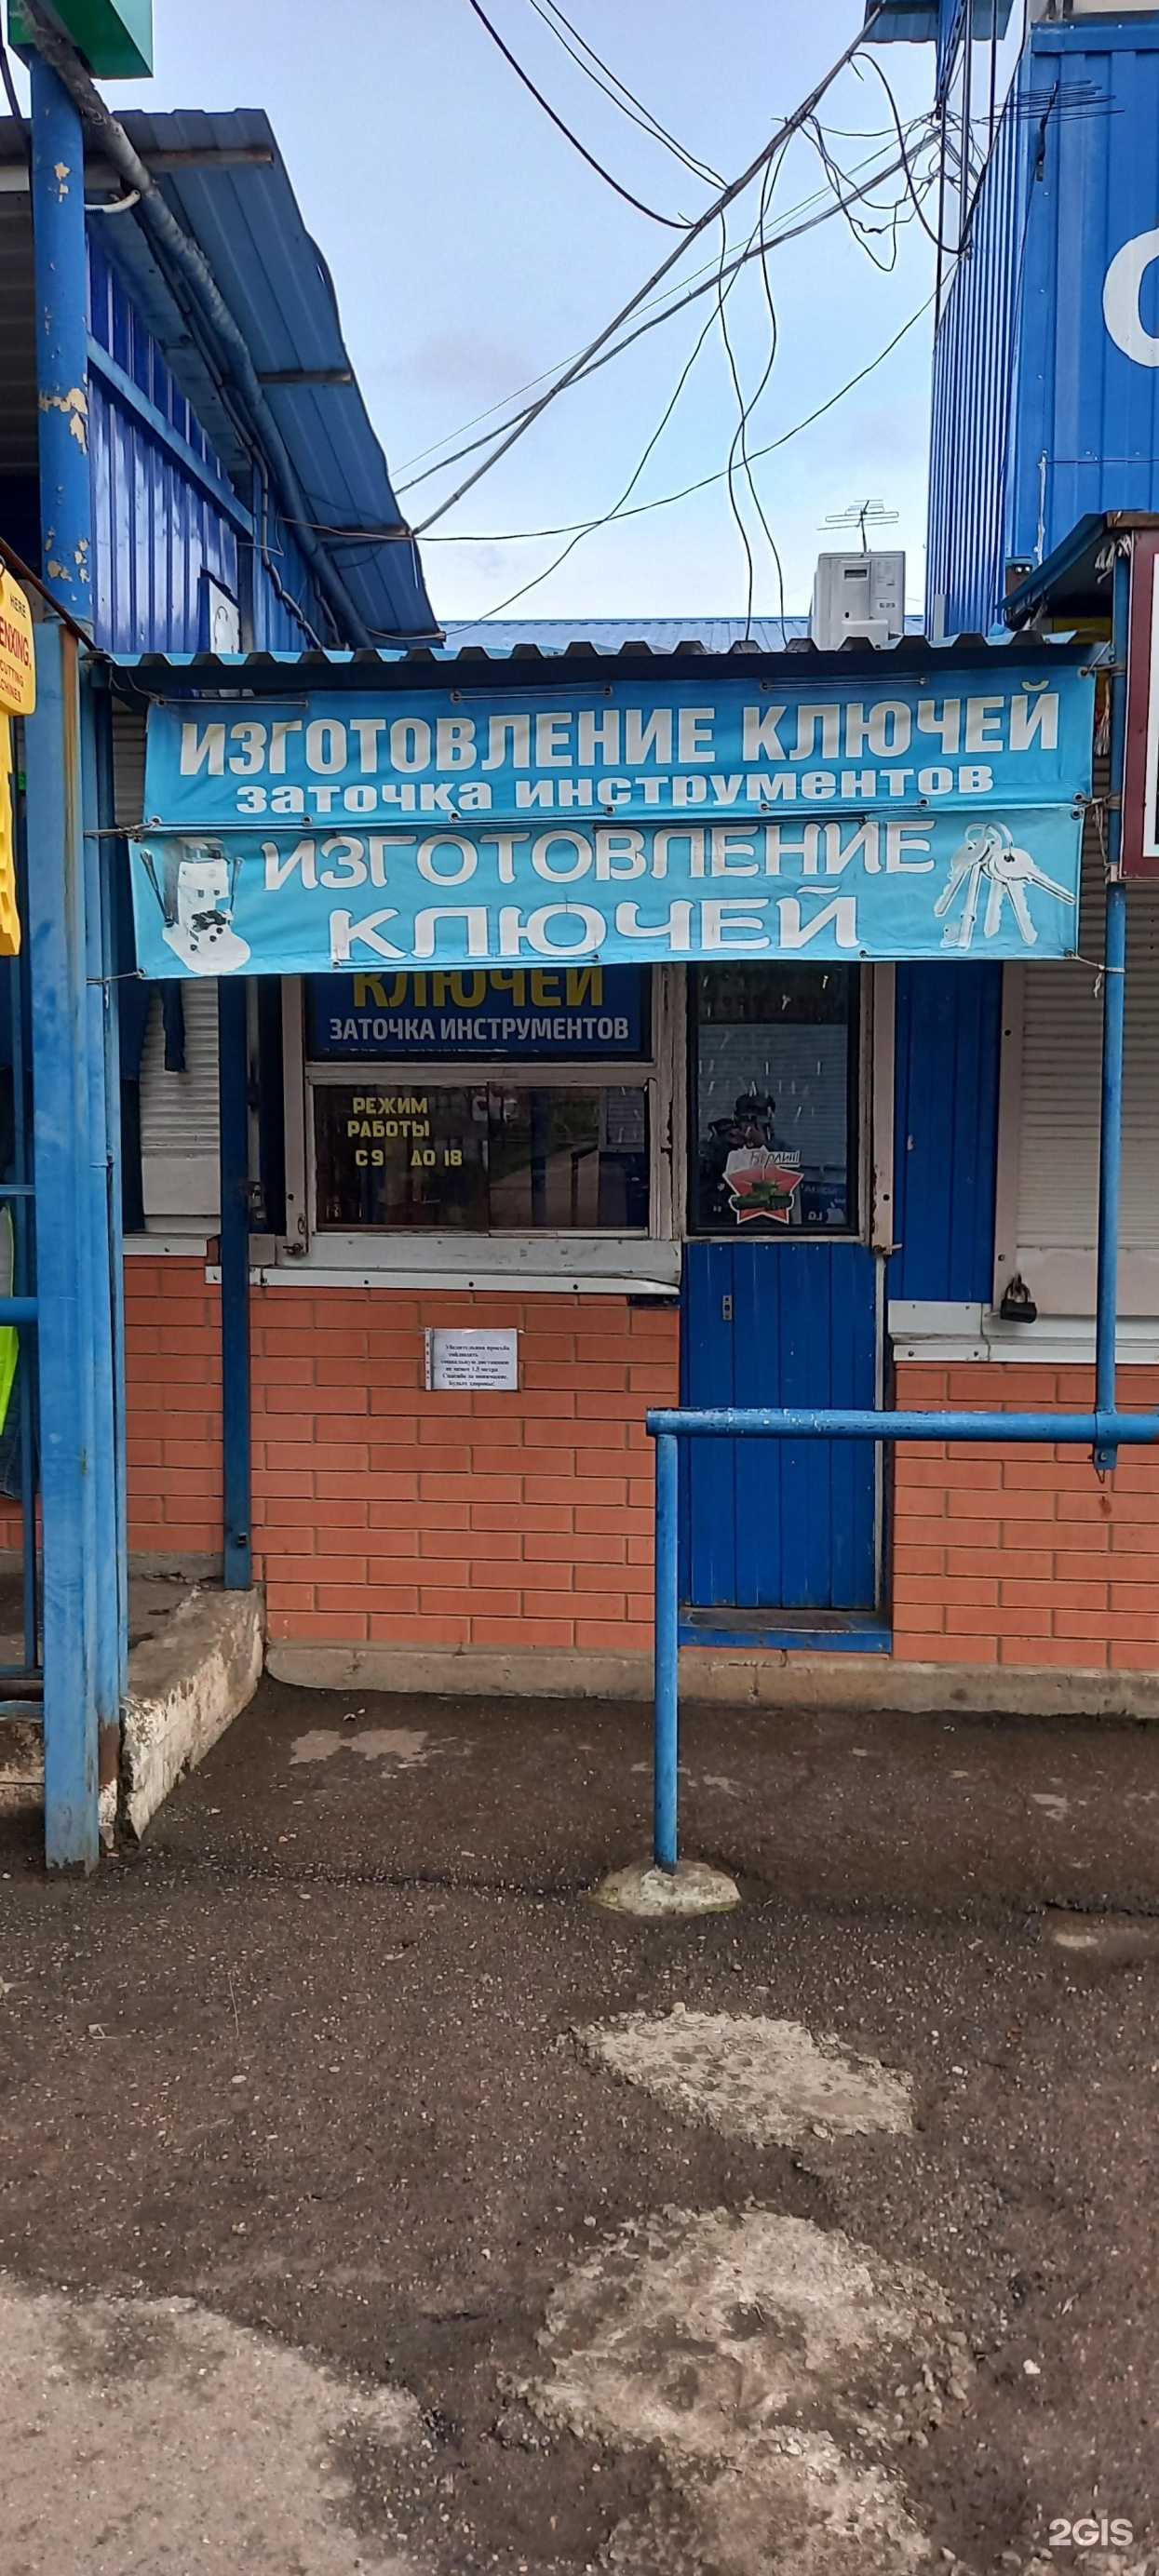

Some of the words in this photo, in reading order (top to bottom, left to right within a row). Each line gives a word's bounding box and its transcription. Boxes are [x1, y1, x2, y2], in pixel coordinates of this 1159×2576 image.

[180, 706, 716, 776] ИЗГОТОВЛЕНИЕ
[742, 680, 1059, 761] КЛЮЧЕЙ
[236, 780, 492, 813] заточка
[515, 765, 994, 809] инструментов
[261, 820, 937, 892] ИЗГОТОВЛЕНИЕ
[329, 885, 861, 961] КЛЮЧЕЙ
[330, 1018, 435, 1040] ЗАТОЧКА
[440, 1017, 628, 1040] ИНСТРУМЕНТОВ
[353, 1097, 428, 1114] РЕЖИМ
[347, 1120, 430, 1137] РАБОТЫ
[371, 1149, 384, 1166] 9
[411, 1149, 436, 1166] ДО
[444, 1149, 463, 1166] 18
